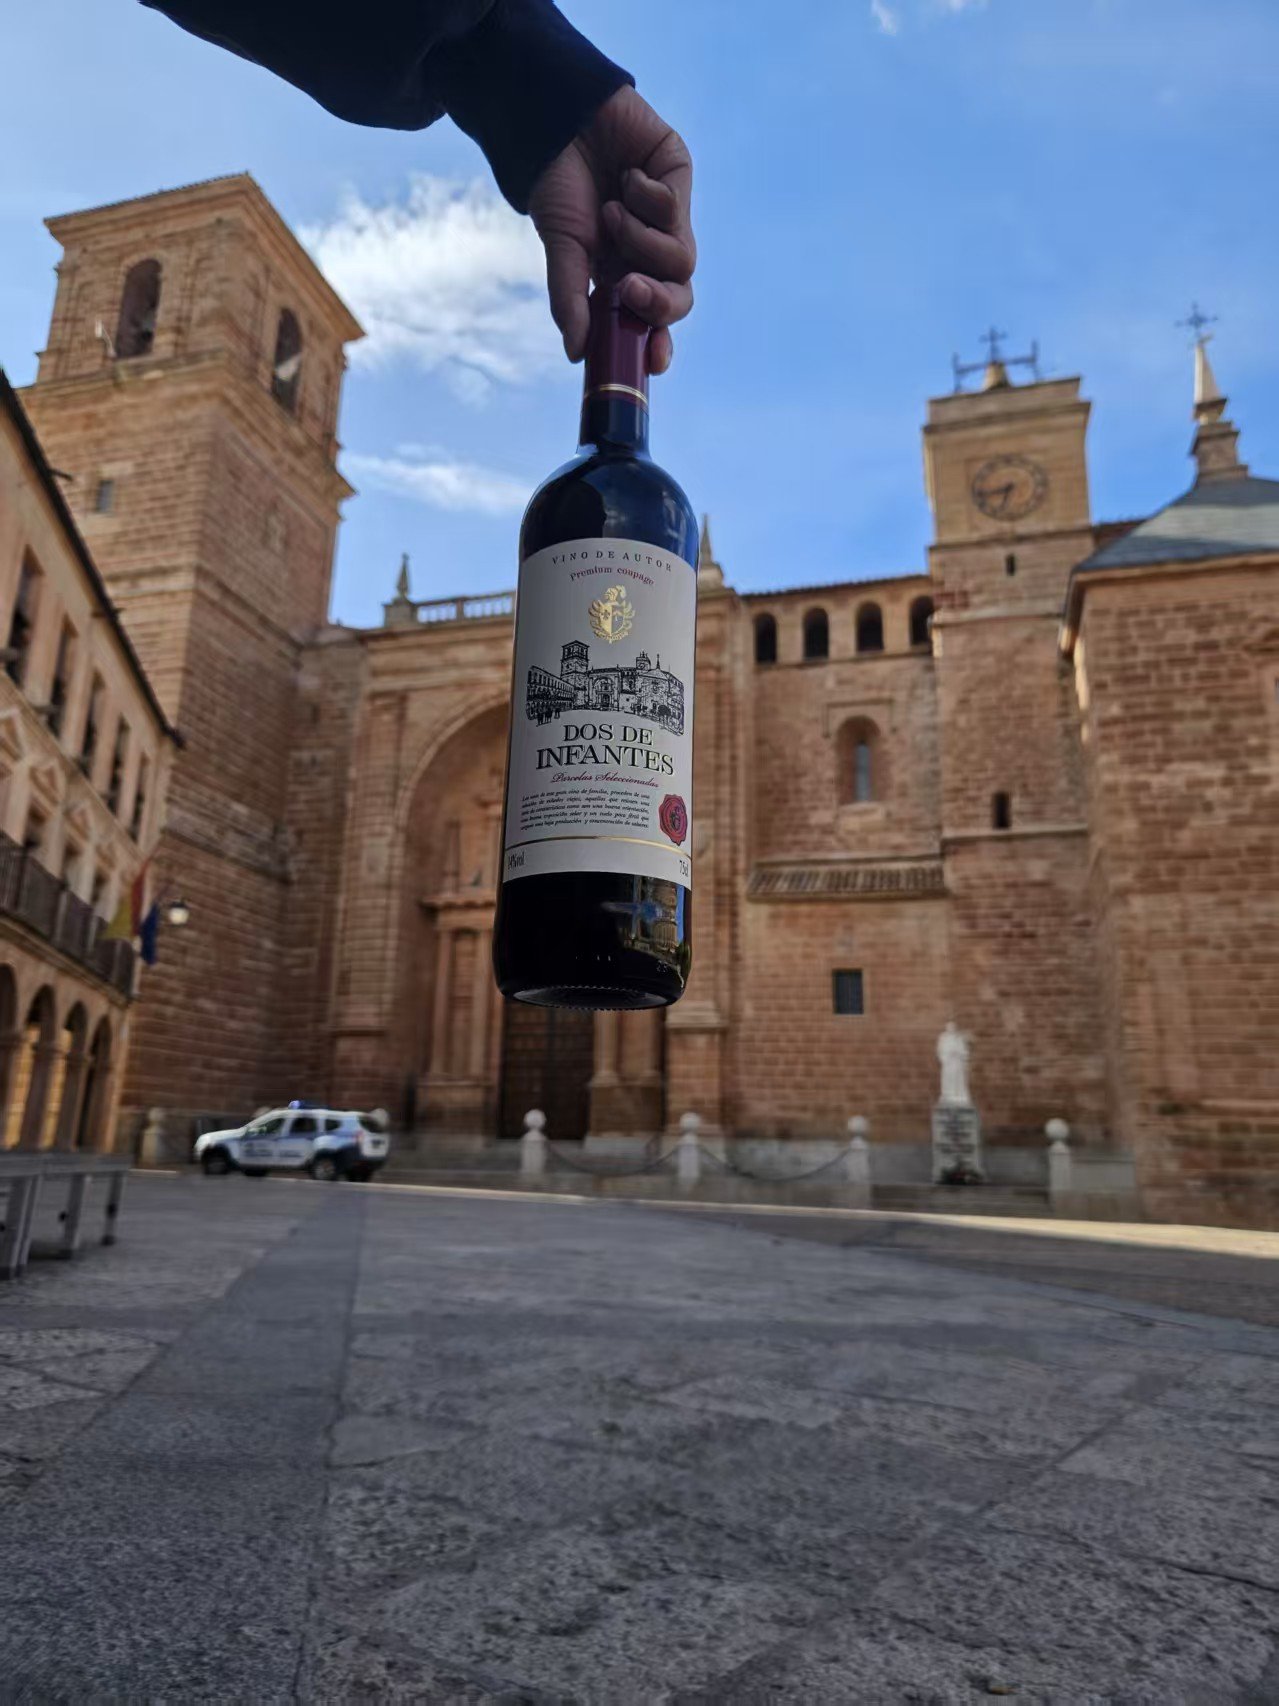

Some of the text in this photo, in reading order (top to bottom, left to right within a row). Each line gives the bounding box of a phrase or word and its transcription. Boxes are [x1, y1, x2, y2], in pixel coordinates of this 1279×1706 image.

[552, 551, 672, 572] VINO DE AUTOR
[569, 566, 612, 581] Premium
[563, 724, 653, 745] DOS DE
[536, 745, 674, 775] INFANTES
[551, 771, 659, 787] Parcelas Seleccionadas
